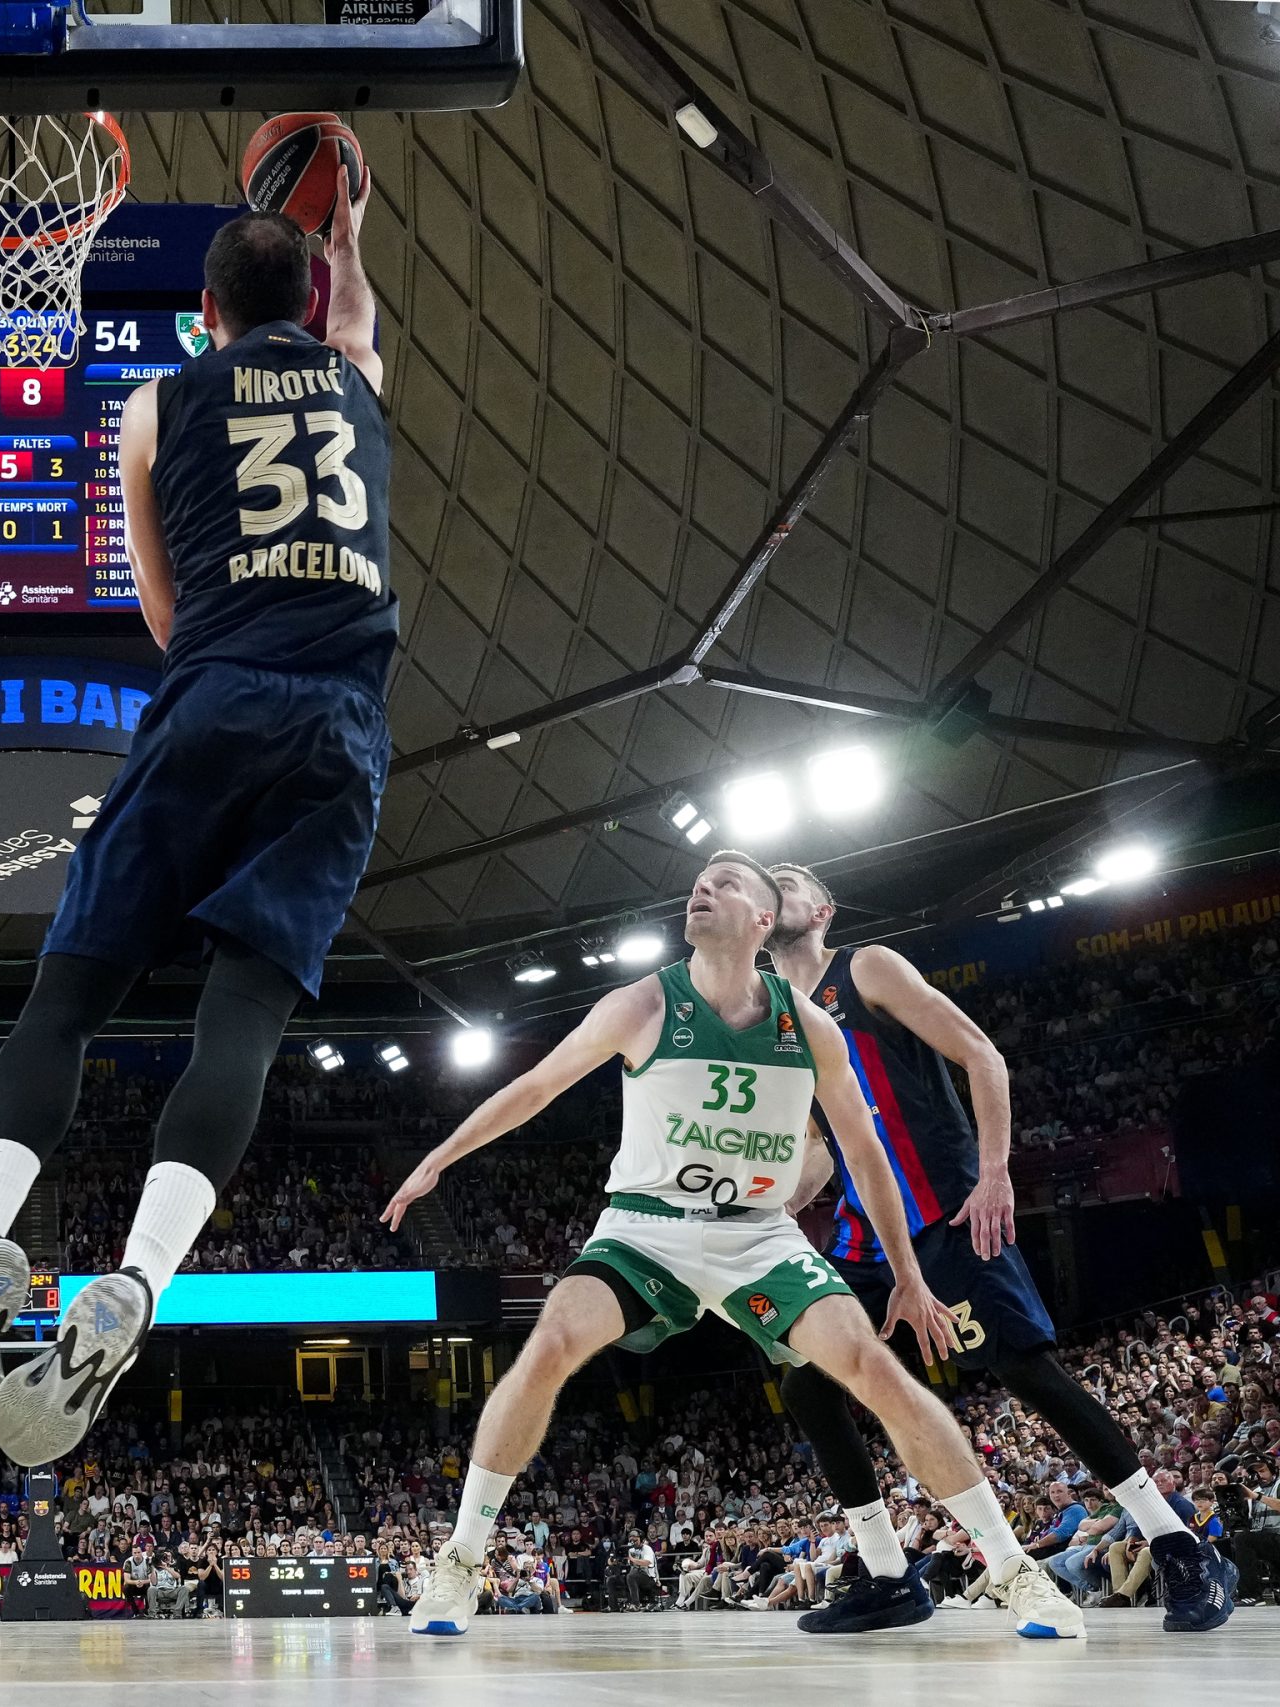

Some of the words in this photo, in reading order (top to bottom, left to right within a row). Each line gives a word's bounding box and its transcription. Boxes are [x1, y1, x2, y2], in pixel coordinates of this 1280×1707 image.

[341, 3, 414, 14] AIRLINES
[271, 144, 300, 177] AIRLINES
[94, 320, 141, 352] 54
[233, 356, 345, 404] MIROTIĆ
[22, 378, 42, 406] 8
[101, 401, 106, 411] 1
[99, 418, 106, 427] 3
[13, 438, 51, 449] FALTES
[99, 435, 106, 444] 4
[99, 452, 106, 461] 8
[0, 454, 18, 479] 5
[50, 458, 63, 477] 3
[94, 469, 106, 478] 10
[227, 410, 369, 537] 33
[95, 486, 106, 496] 15
[36, 502, 68, 513] MORT
[95, 503, 107, 513] 16
[2, 520, 17, 540] 0
[52, 520, 63, 540] 1
[96, 520, 107, 529] 17
[94, 537, 107, 546] 25
[94, 554, 107, 563] 33
[96, 570, 107, 580] 51
[21, 585, 74, 595] Assistència
[94, 587, 107, 597] 92
[21, 594, 59, 605] Sanitària
[702, 1063, 758, 1115] 33
[666, 1112, 796, 1165] ŽALGIRIS
[30, 1275, 53, 1286] 3:24
[46, 1289, 58, 1308] 8
[231, 1568, 251, 1580] 55
[270, 1567, 305, 1580] 3:24
[320, 1568, 328, 1579] 3
[349, 1566, 368, 1579] 54
[235, 1600, 244, 1611] 5
[356, 1598, 365, 1609] 3
